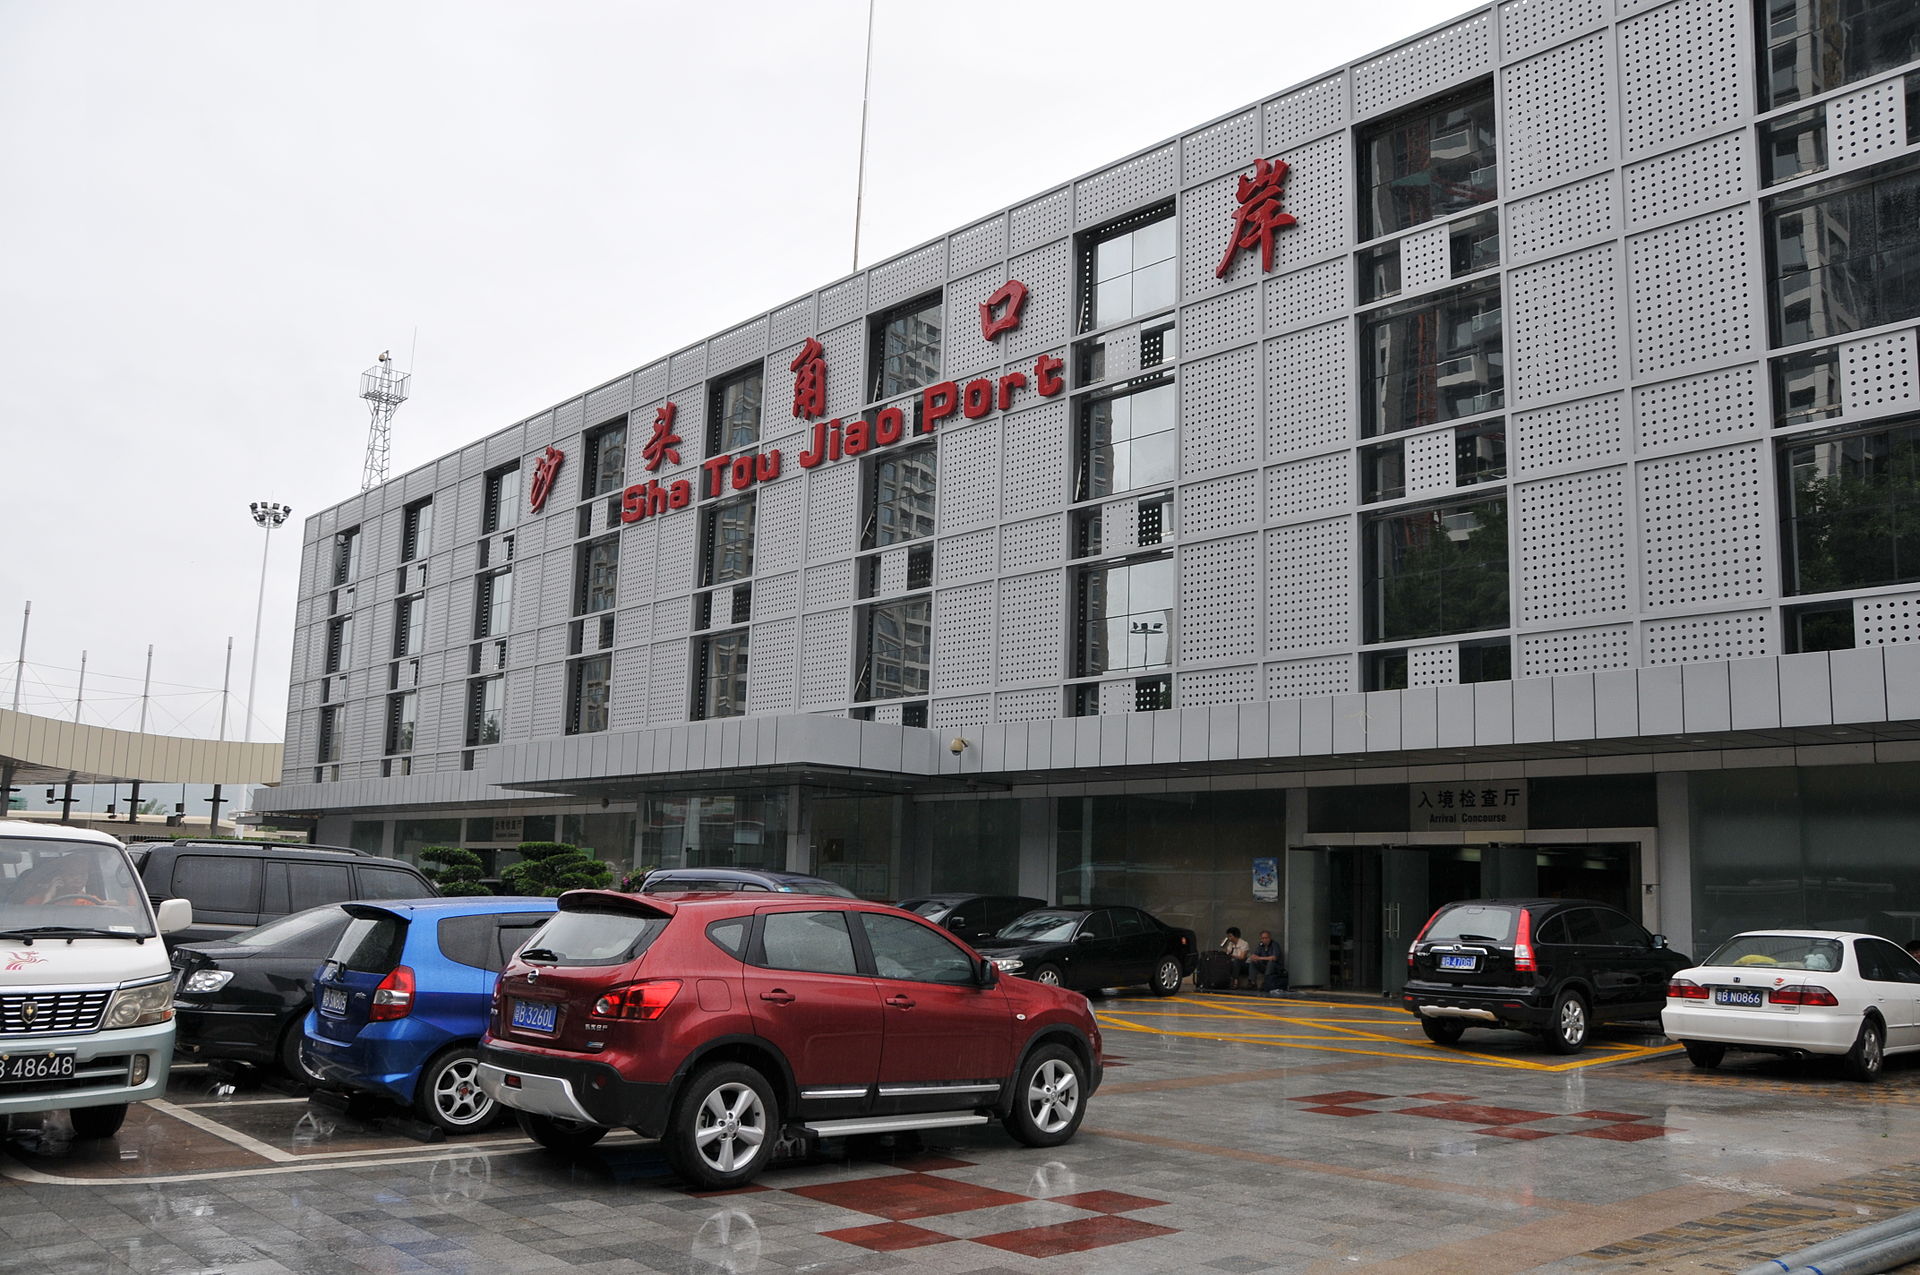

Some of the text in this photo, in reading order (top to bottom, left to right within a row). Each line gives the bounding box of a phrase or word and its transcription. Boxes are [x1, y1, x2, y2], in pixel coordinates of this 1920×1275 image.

[530, 158, 1297, 515] 沙头角口岸
[621, 353, 1064, 523] Sha Tou Jiao Port
[1418, 788, 1520, 808] 入境检查厅
[1430, 812, 1507, 824] Arrival Concourse
